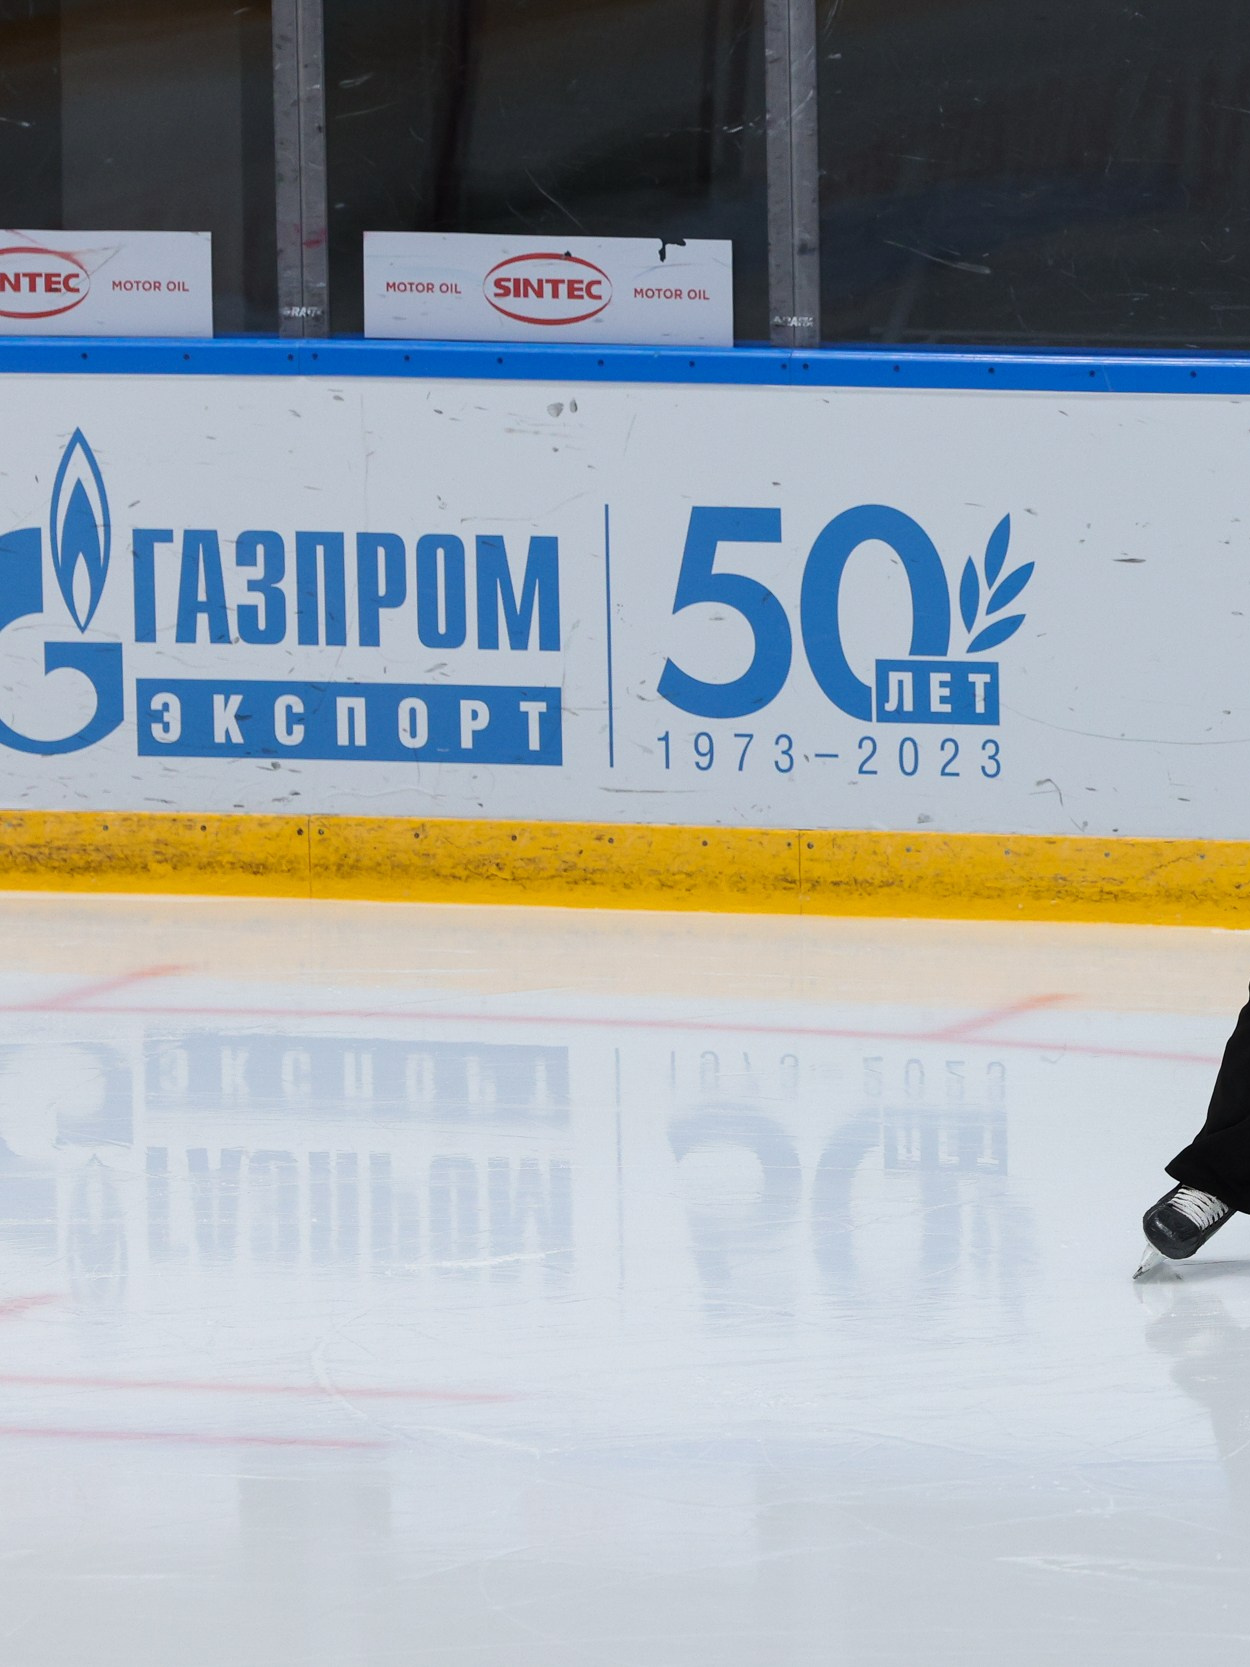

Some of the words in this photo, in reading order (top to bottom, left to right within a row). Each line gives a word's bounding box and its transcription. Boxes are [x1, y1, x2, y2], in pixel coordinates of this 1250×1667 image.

[111, 280, 162, 292] MOTOR
[166, 281, 190, 292] OIL
[385, 281, 435, 294] MOTOR
[439, 282, 462, 295] OIL
[493, 277, 603, 301] SINTEC
[633, 287, 683, 300] MOTOR
[687, 288, 711, 301] OIL
[132, 528, 562, 652] ГАЗПРОМ
[656, 503, 952, 723] 50
[884, 671, 991, 714] ЛЕТ
[150, 692, 548, 752] ЭКСПОРТ
